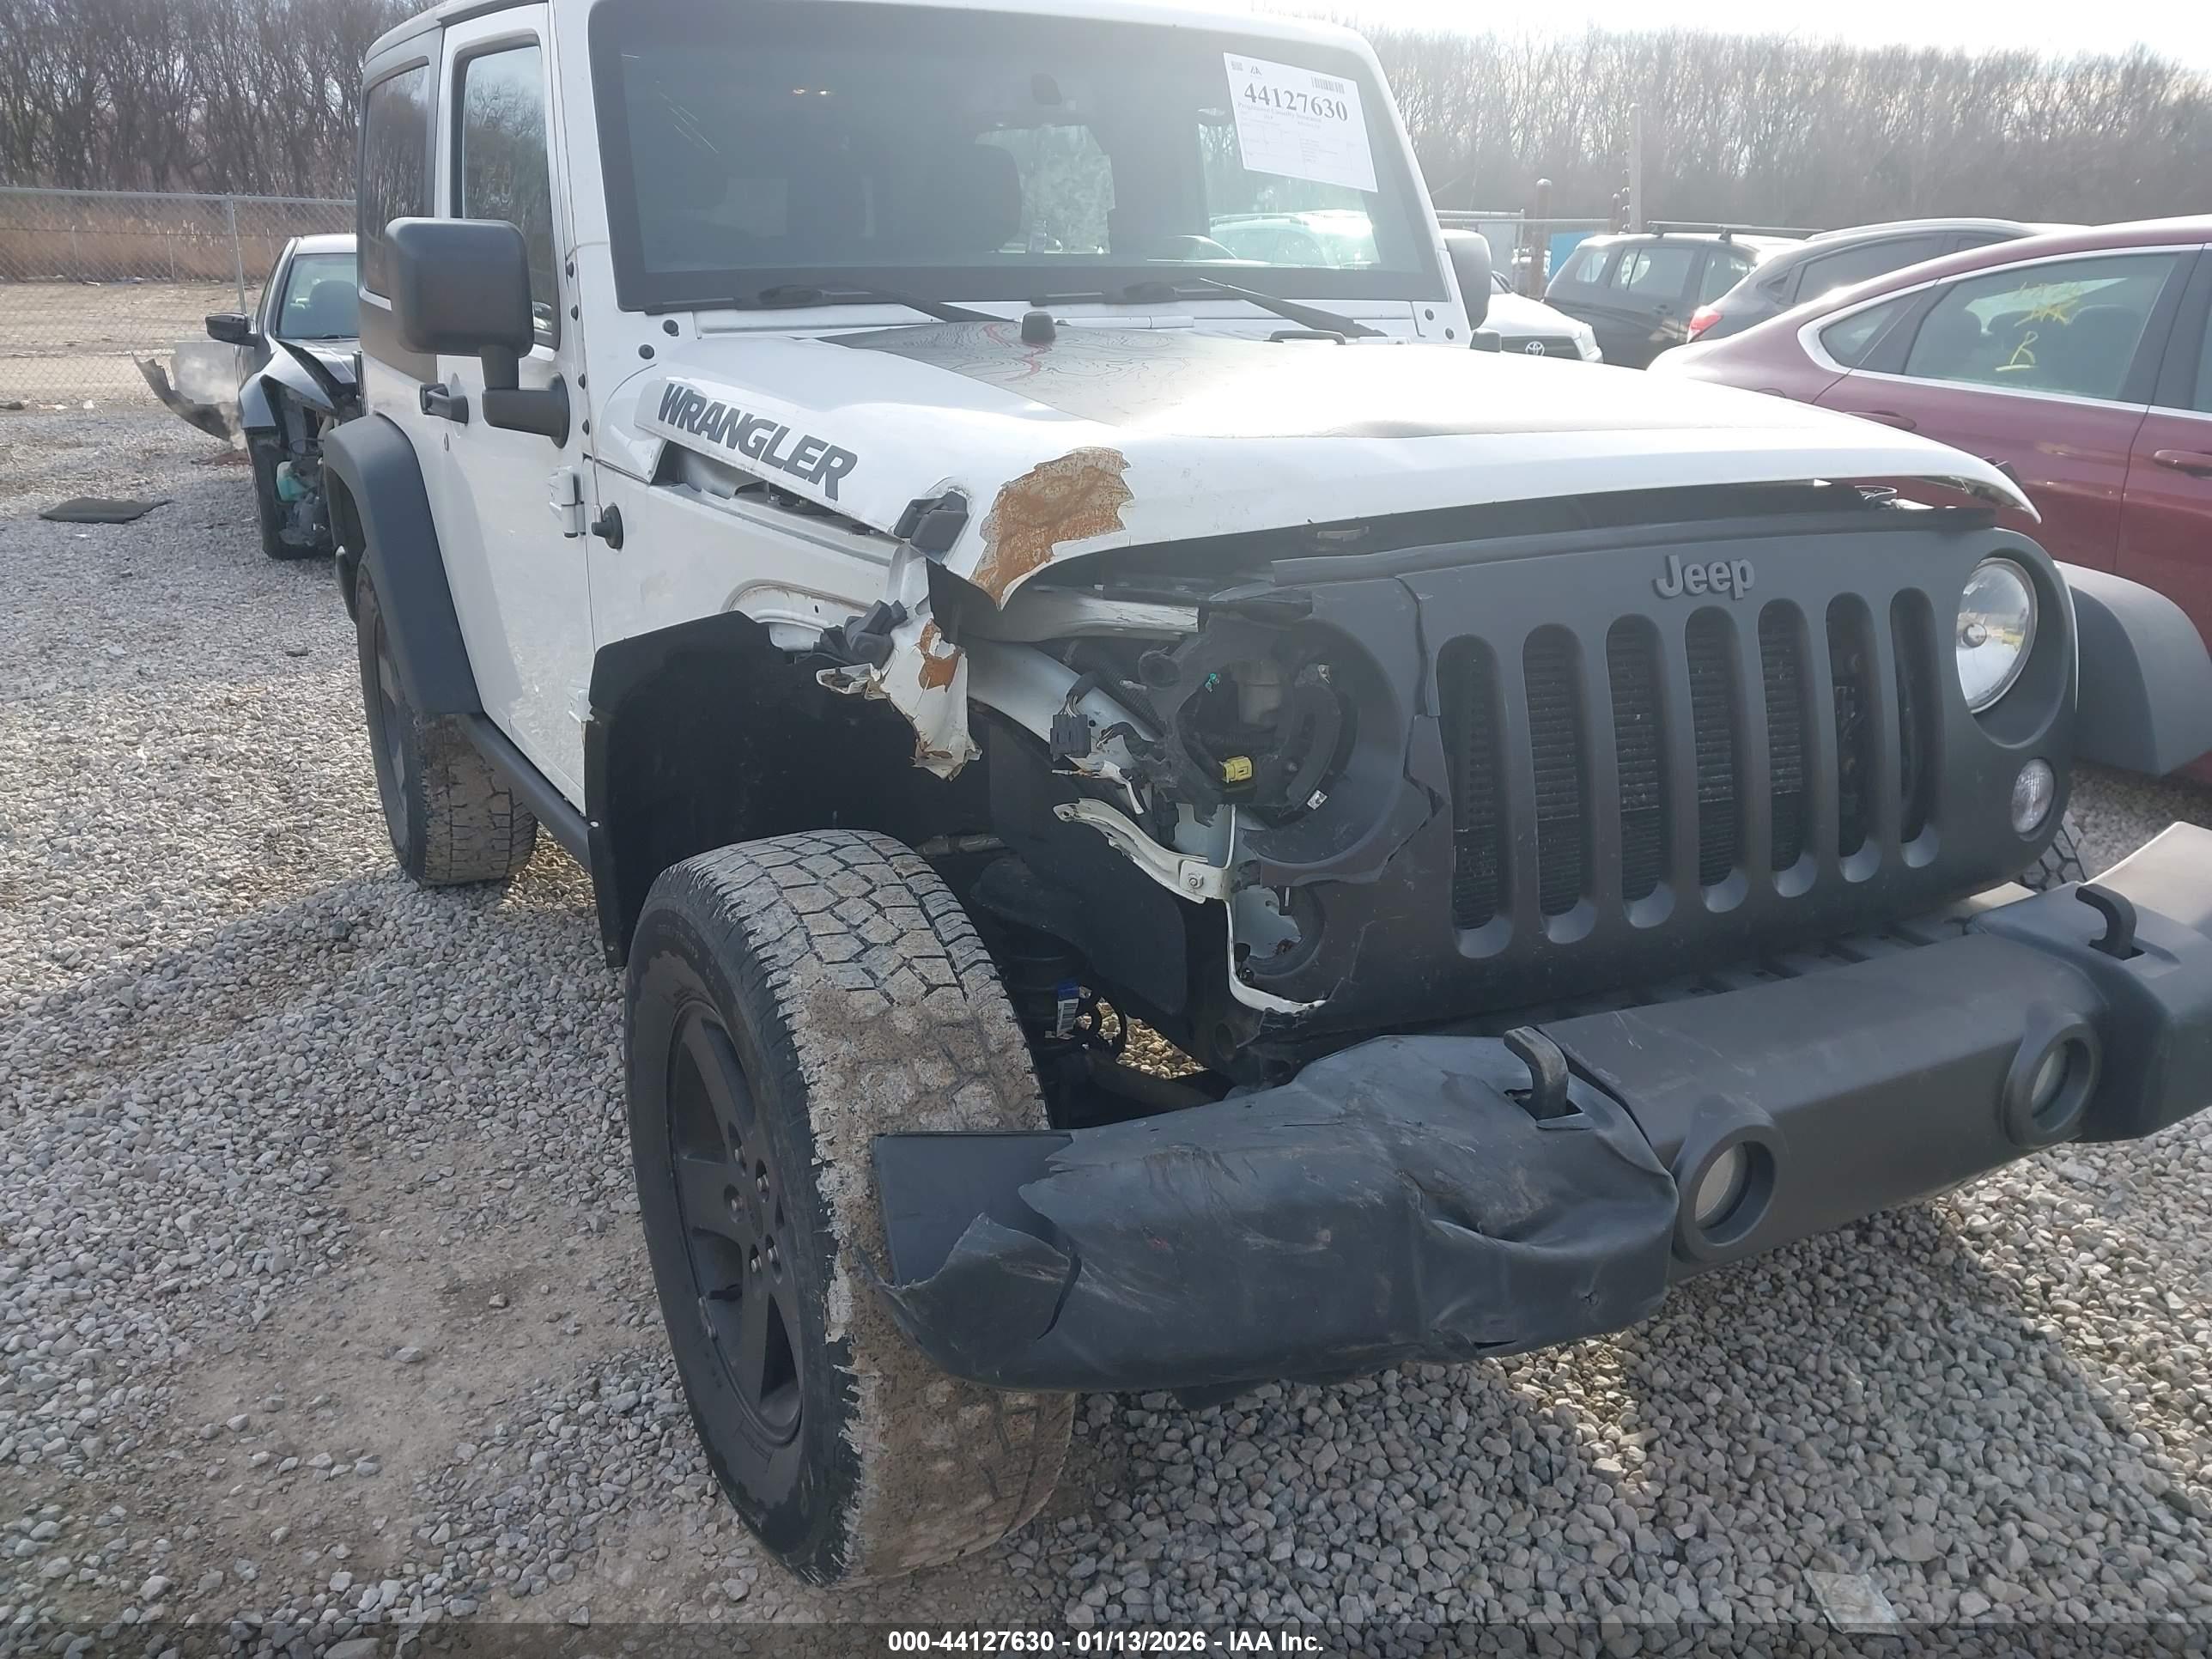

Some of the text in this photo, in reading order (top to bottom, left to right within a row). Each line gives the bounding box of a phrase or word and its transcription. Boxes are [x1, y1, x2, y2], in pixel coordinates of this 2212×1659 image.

[1243, 82, 1348, 121] 44127630
[658, 383, 858, 501] WRANGLER
[1653, 554, 1755, 599] Jeep
